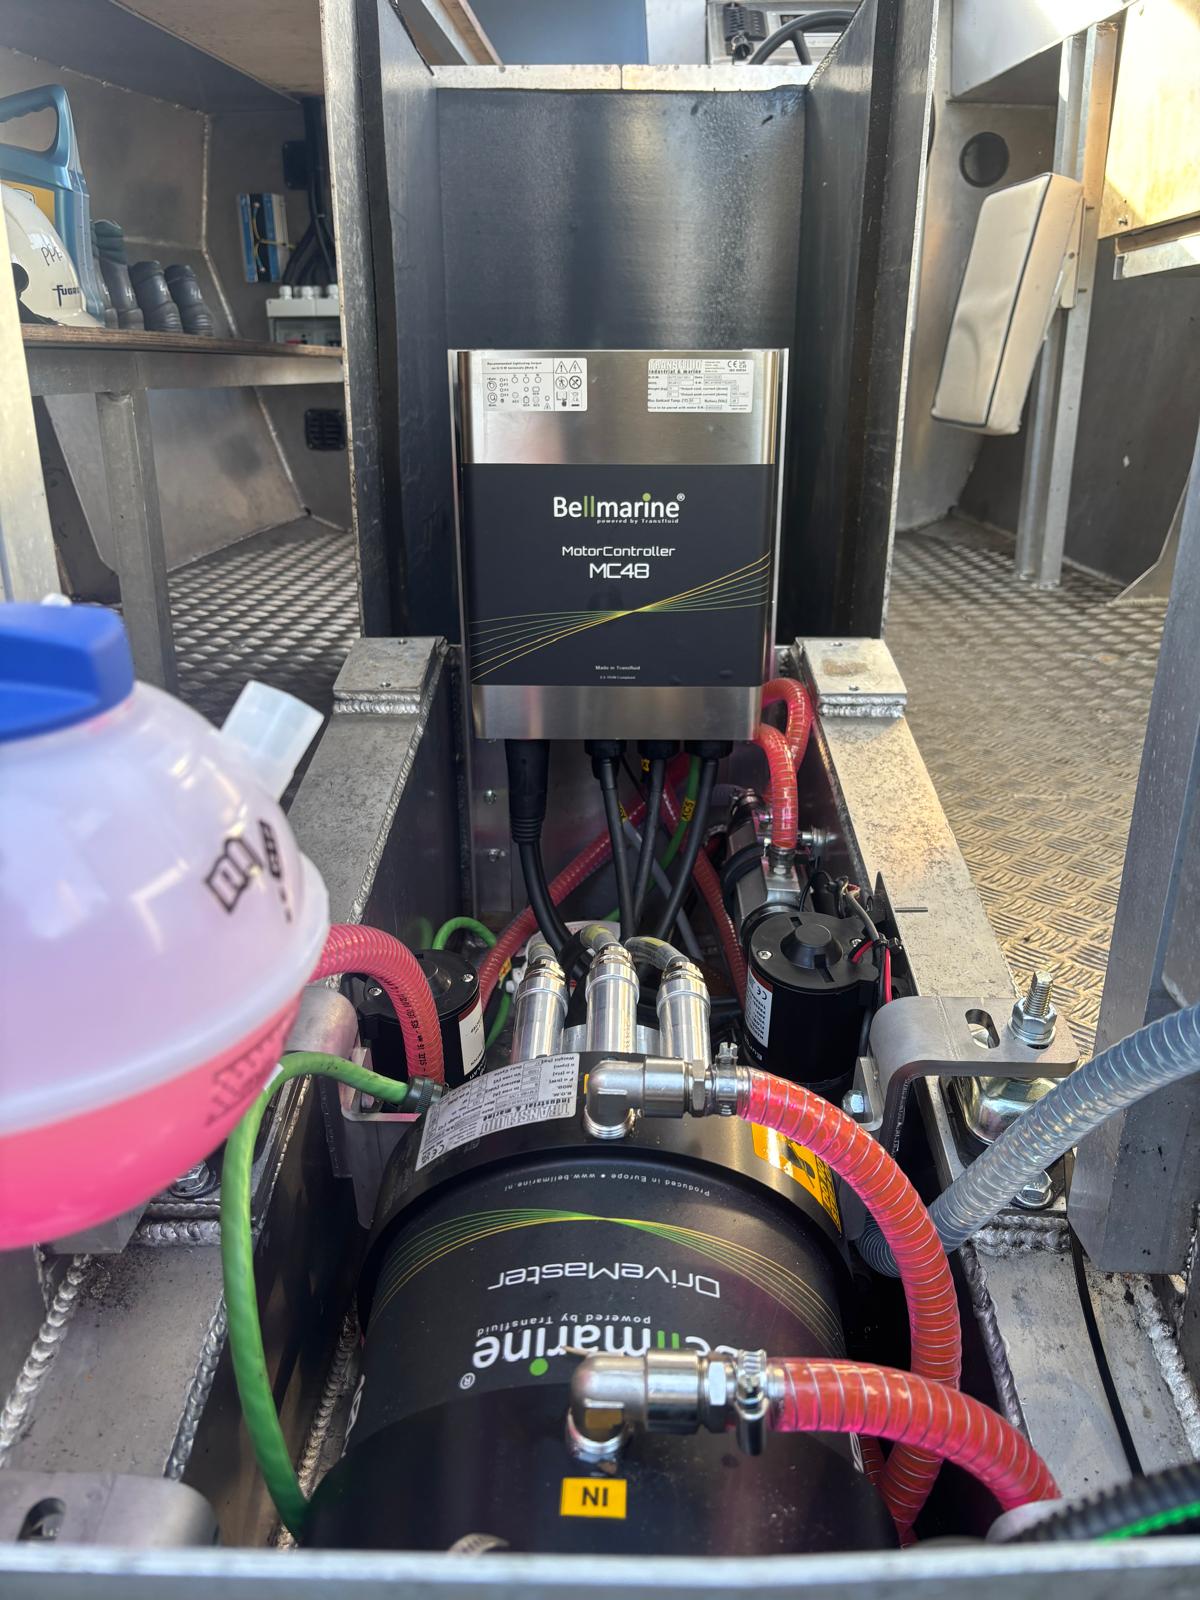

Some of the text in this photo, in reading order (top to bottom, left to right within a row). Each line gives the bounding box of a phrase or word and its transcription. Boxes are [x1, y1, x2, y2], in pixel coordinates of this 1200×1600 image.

[562, 546, 676, 556] MotorController
[589, 563, 650, 578] MC48
[504, 1173, 595, 1191] www.bellmarine.nl
[611, 1173, 647, 1182] Europe
[665, 1179, 710, 1196] Produced
[487, 1261, 720, 1298] DriveMaster
[477, 1313, 651, 1337] powered by Transfluid
[581, 1486, 608, 1507] IN
